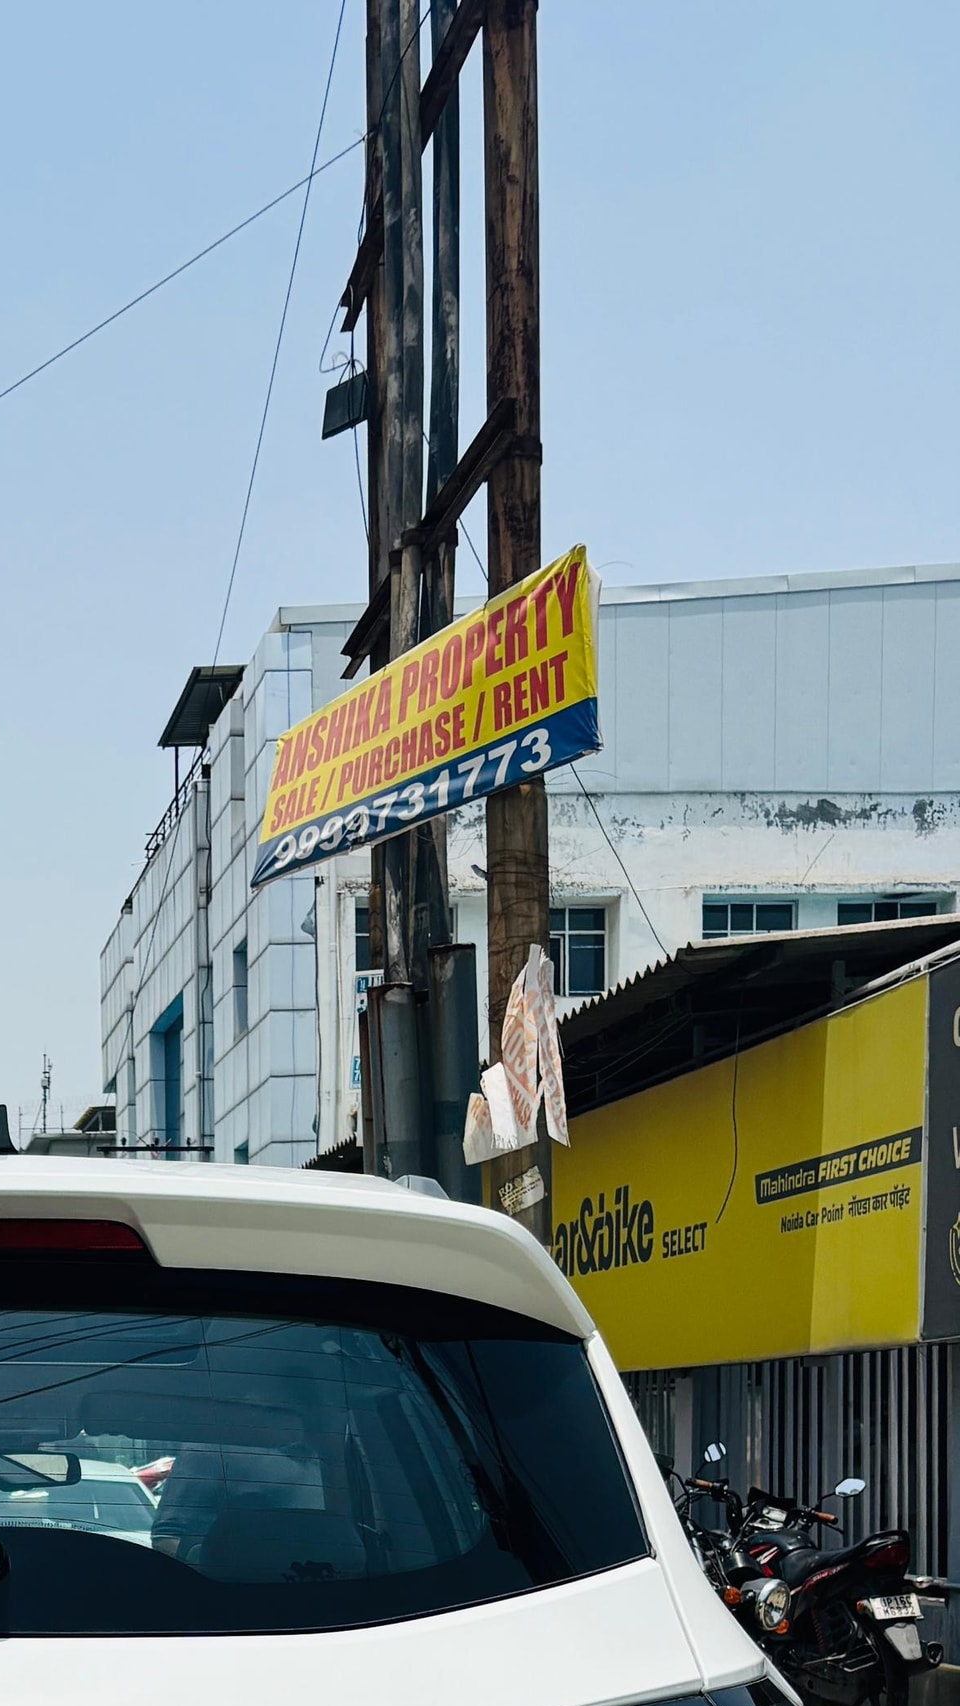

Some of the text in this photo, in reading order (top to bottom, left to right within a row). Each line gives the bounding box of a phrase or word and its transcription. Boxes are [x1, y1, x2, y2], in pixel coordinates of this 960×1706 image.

[272, 562, 581, 791] ANSHIKA PROPERTY
[270, 777, 318, 833] SALE
[336, 702, 466, 803] PURCHASE
[493, 651, 568, 732] RENT
[273, 728, 553, 870] 9999731773
[760, 1137, 913, 1198] Mahindra FIRST CHOICE
[872, 1193, 889, 1212] कार
[551, 1184, 654, 1277] ar&bike
[662, 1222, 707, 1259] SELECT
[781, 1204, 844, 1234] Noida Car Point
